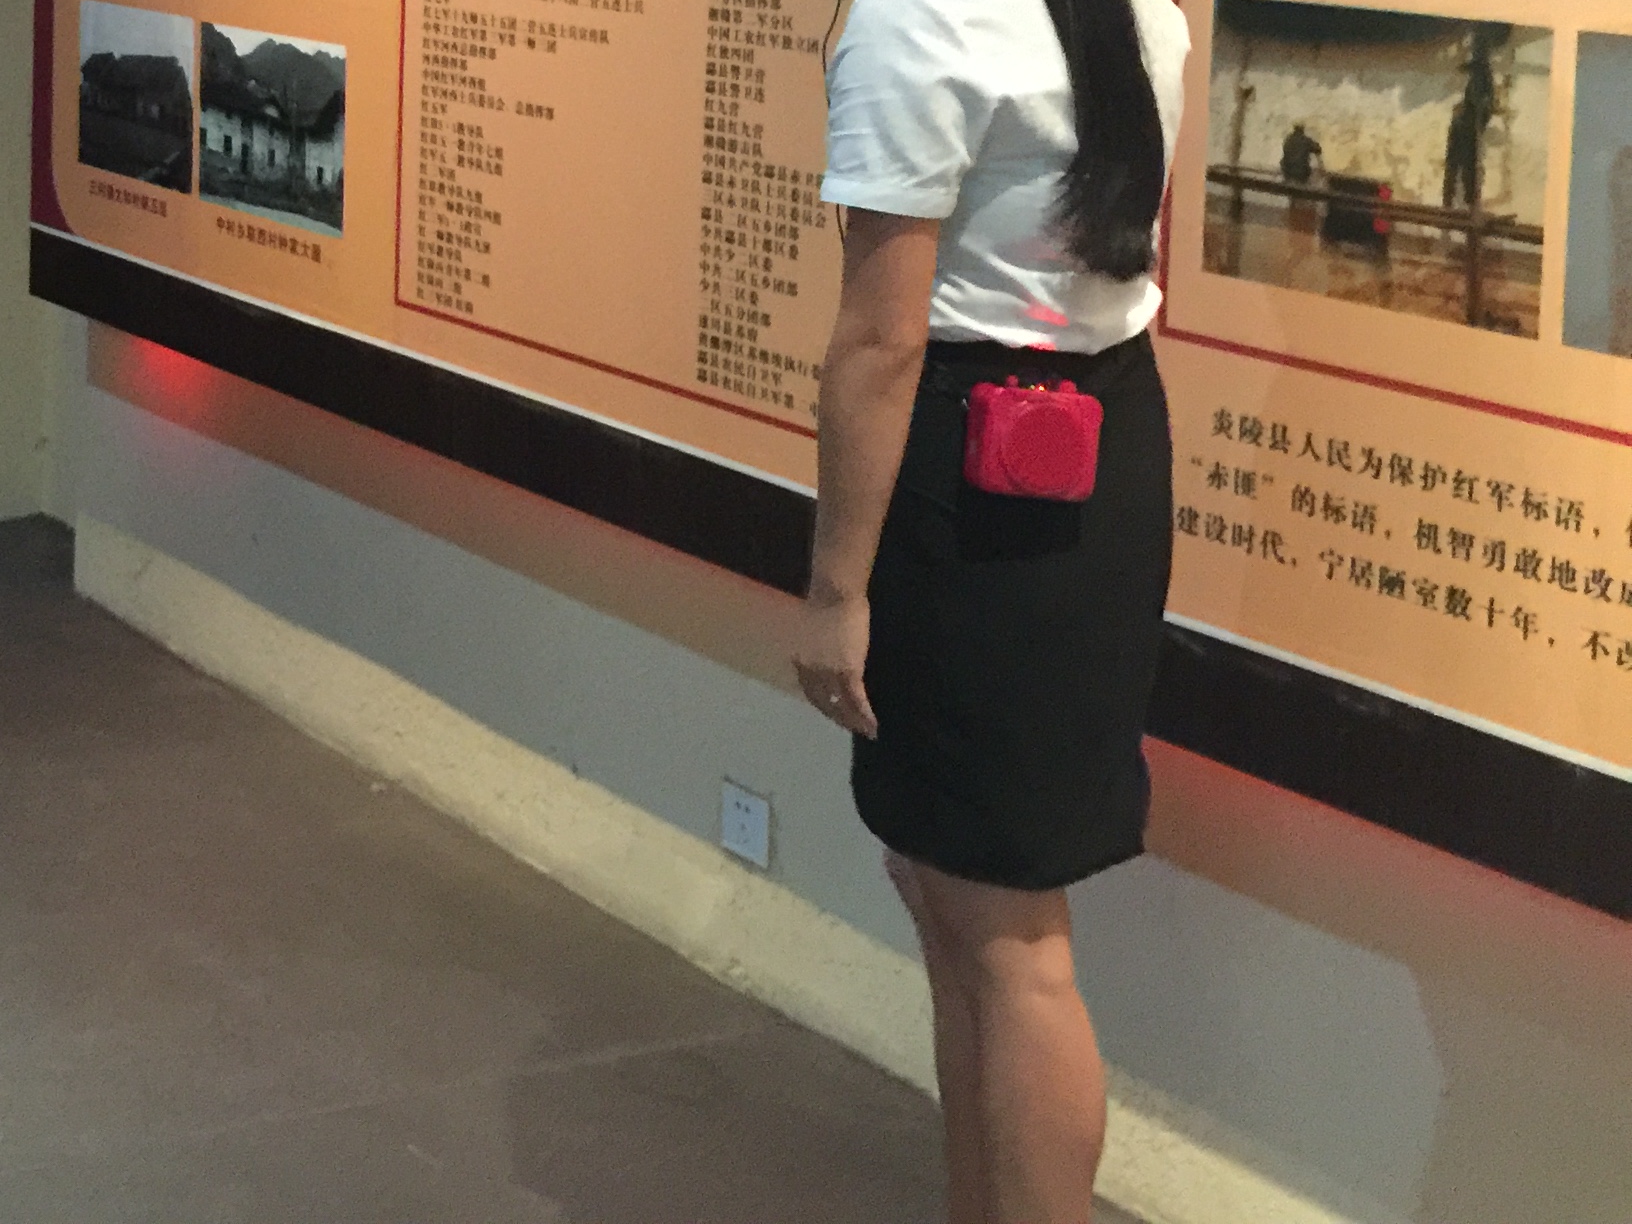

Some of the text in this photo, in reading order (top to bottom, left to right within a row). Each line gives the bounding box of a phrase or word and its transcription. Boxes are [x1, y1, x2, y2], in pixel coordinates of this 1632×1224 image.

[1212, 407, 1632, 548] 炎陵县人民为保护红军标语，
